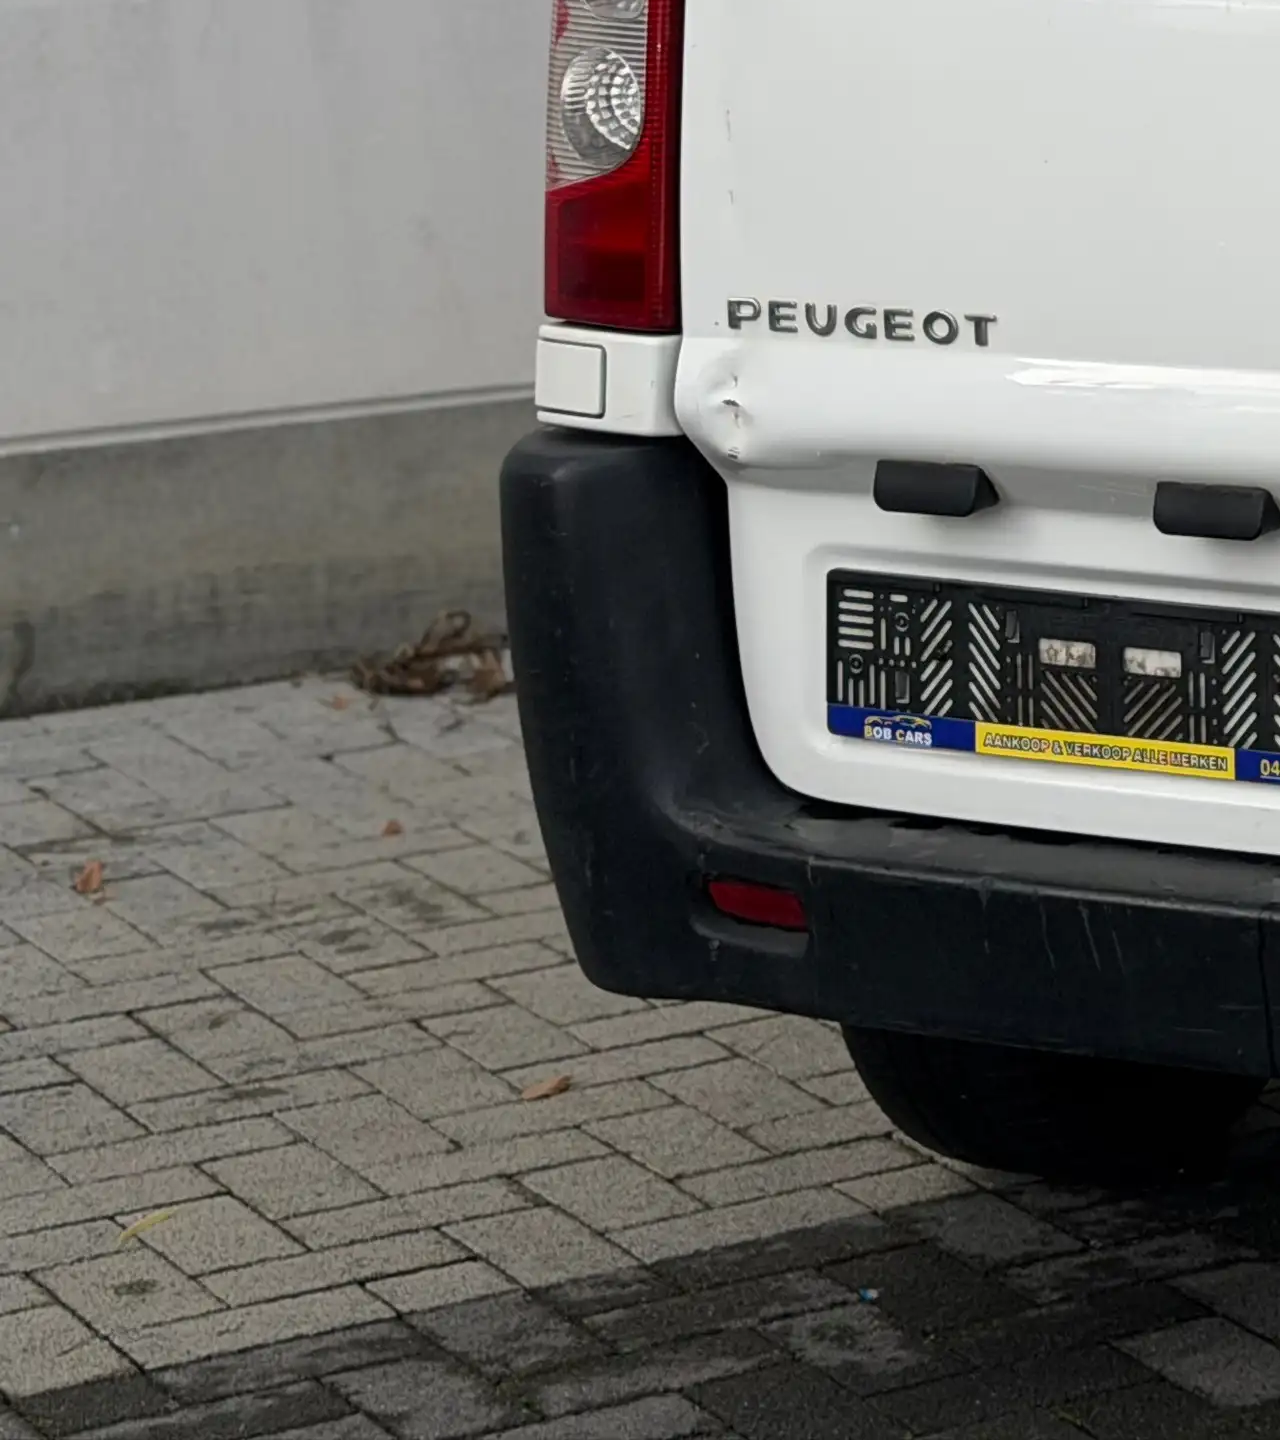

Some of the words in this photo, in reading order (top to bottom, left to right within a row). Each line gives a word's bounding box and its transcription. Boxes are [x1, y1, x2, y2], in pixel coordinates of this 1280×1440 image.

[727, 297, 998, 347] PEUGEOT
[864, 725, 892, 740] BOB
[896, 729, 932, 746] CARS
[984, 732, 1049, 752] AANKOOP
[1052, 741, 1063, 754] &
[1066, 741, 1131, 760] VERKOOP
[1133, 748, 1168, 765] ALLE
[1170, 752, 1227, 771] MERKEN
